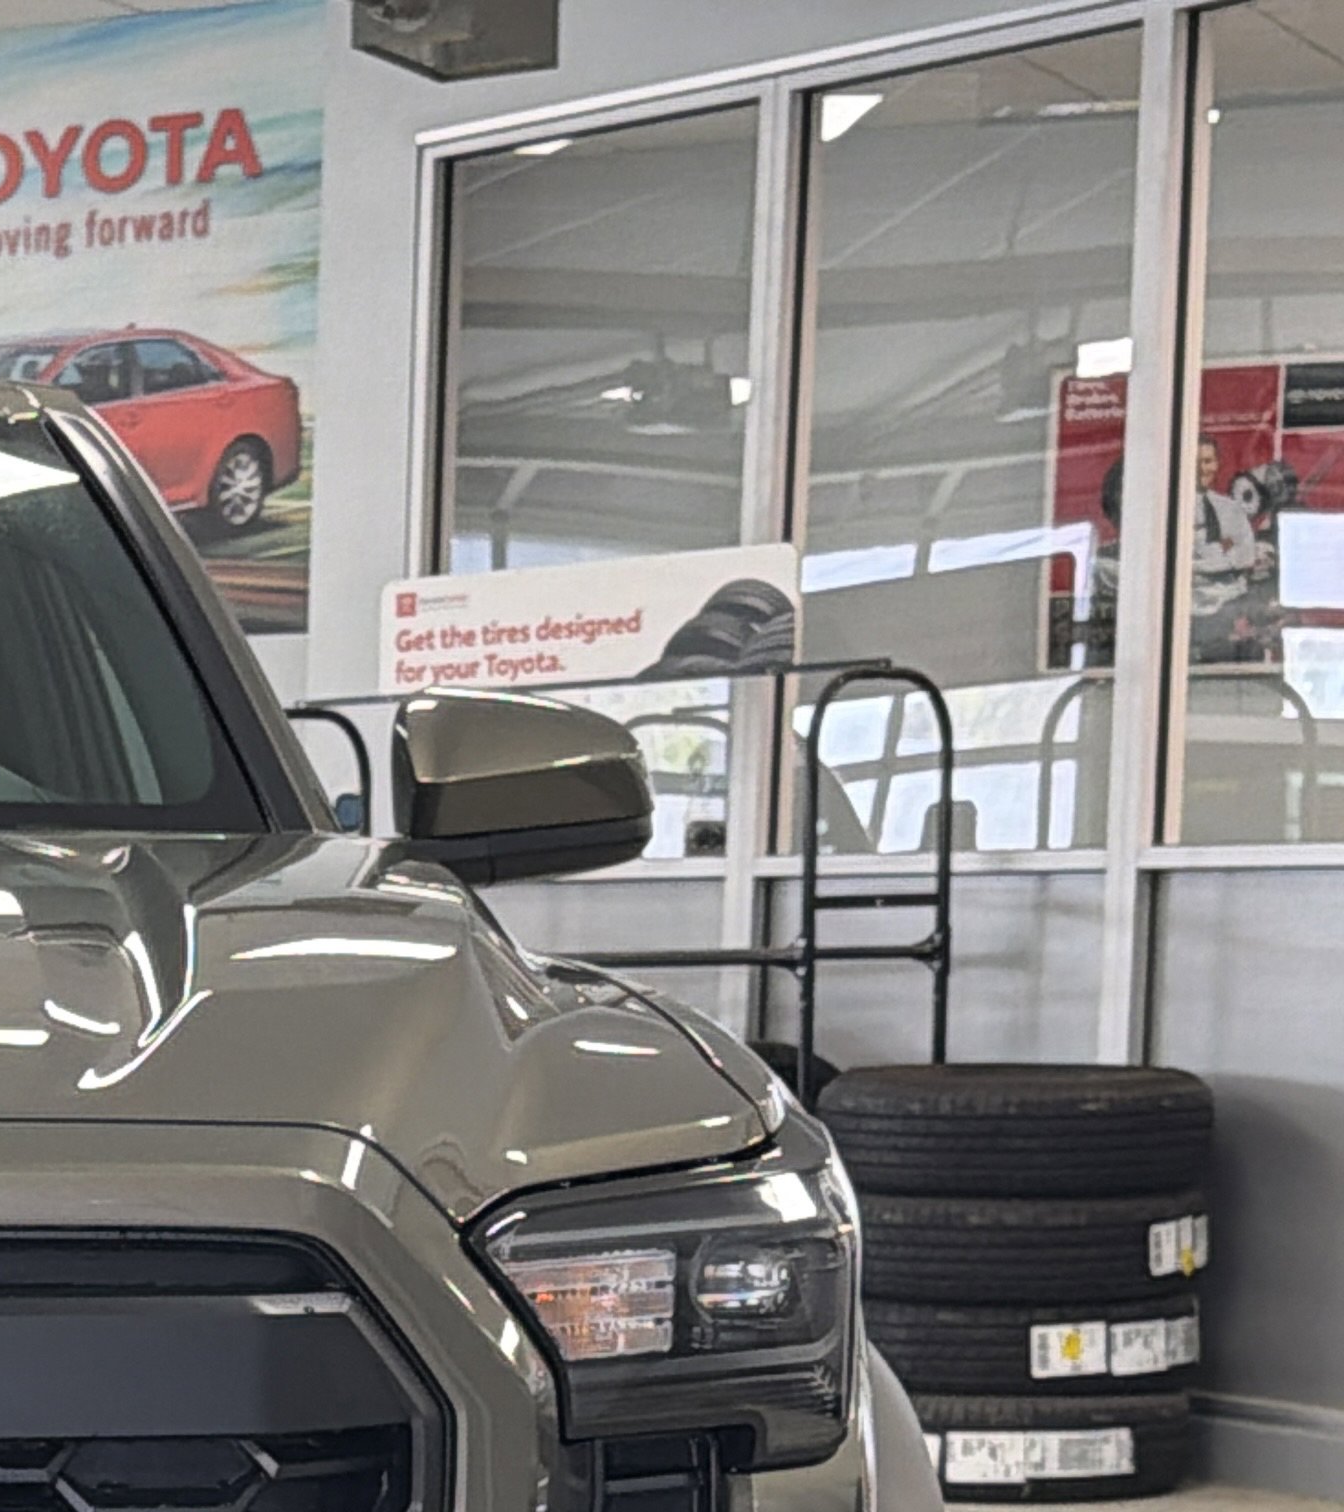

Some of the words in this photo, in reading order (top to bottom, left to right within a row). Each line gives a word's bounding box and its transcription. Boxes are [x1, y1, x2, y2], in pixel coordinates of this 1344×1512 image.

[84, 198, 211, 248] forward
[395, 629, 436, 652] Get
[440, 624, 477, 649] the
[481, 619, 531, 646] tires
[535, 607, 644, 645] designed
[395, 660, 427, 684] for
[430, 659, 480, 685] your
[484, 652, 566, 682] Toyota.
